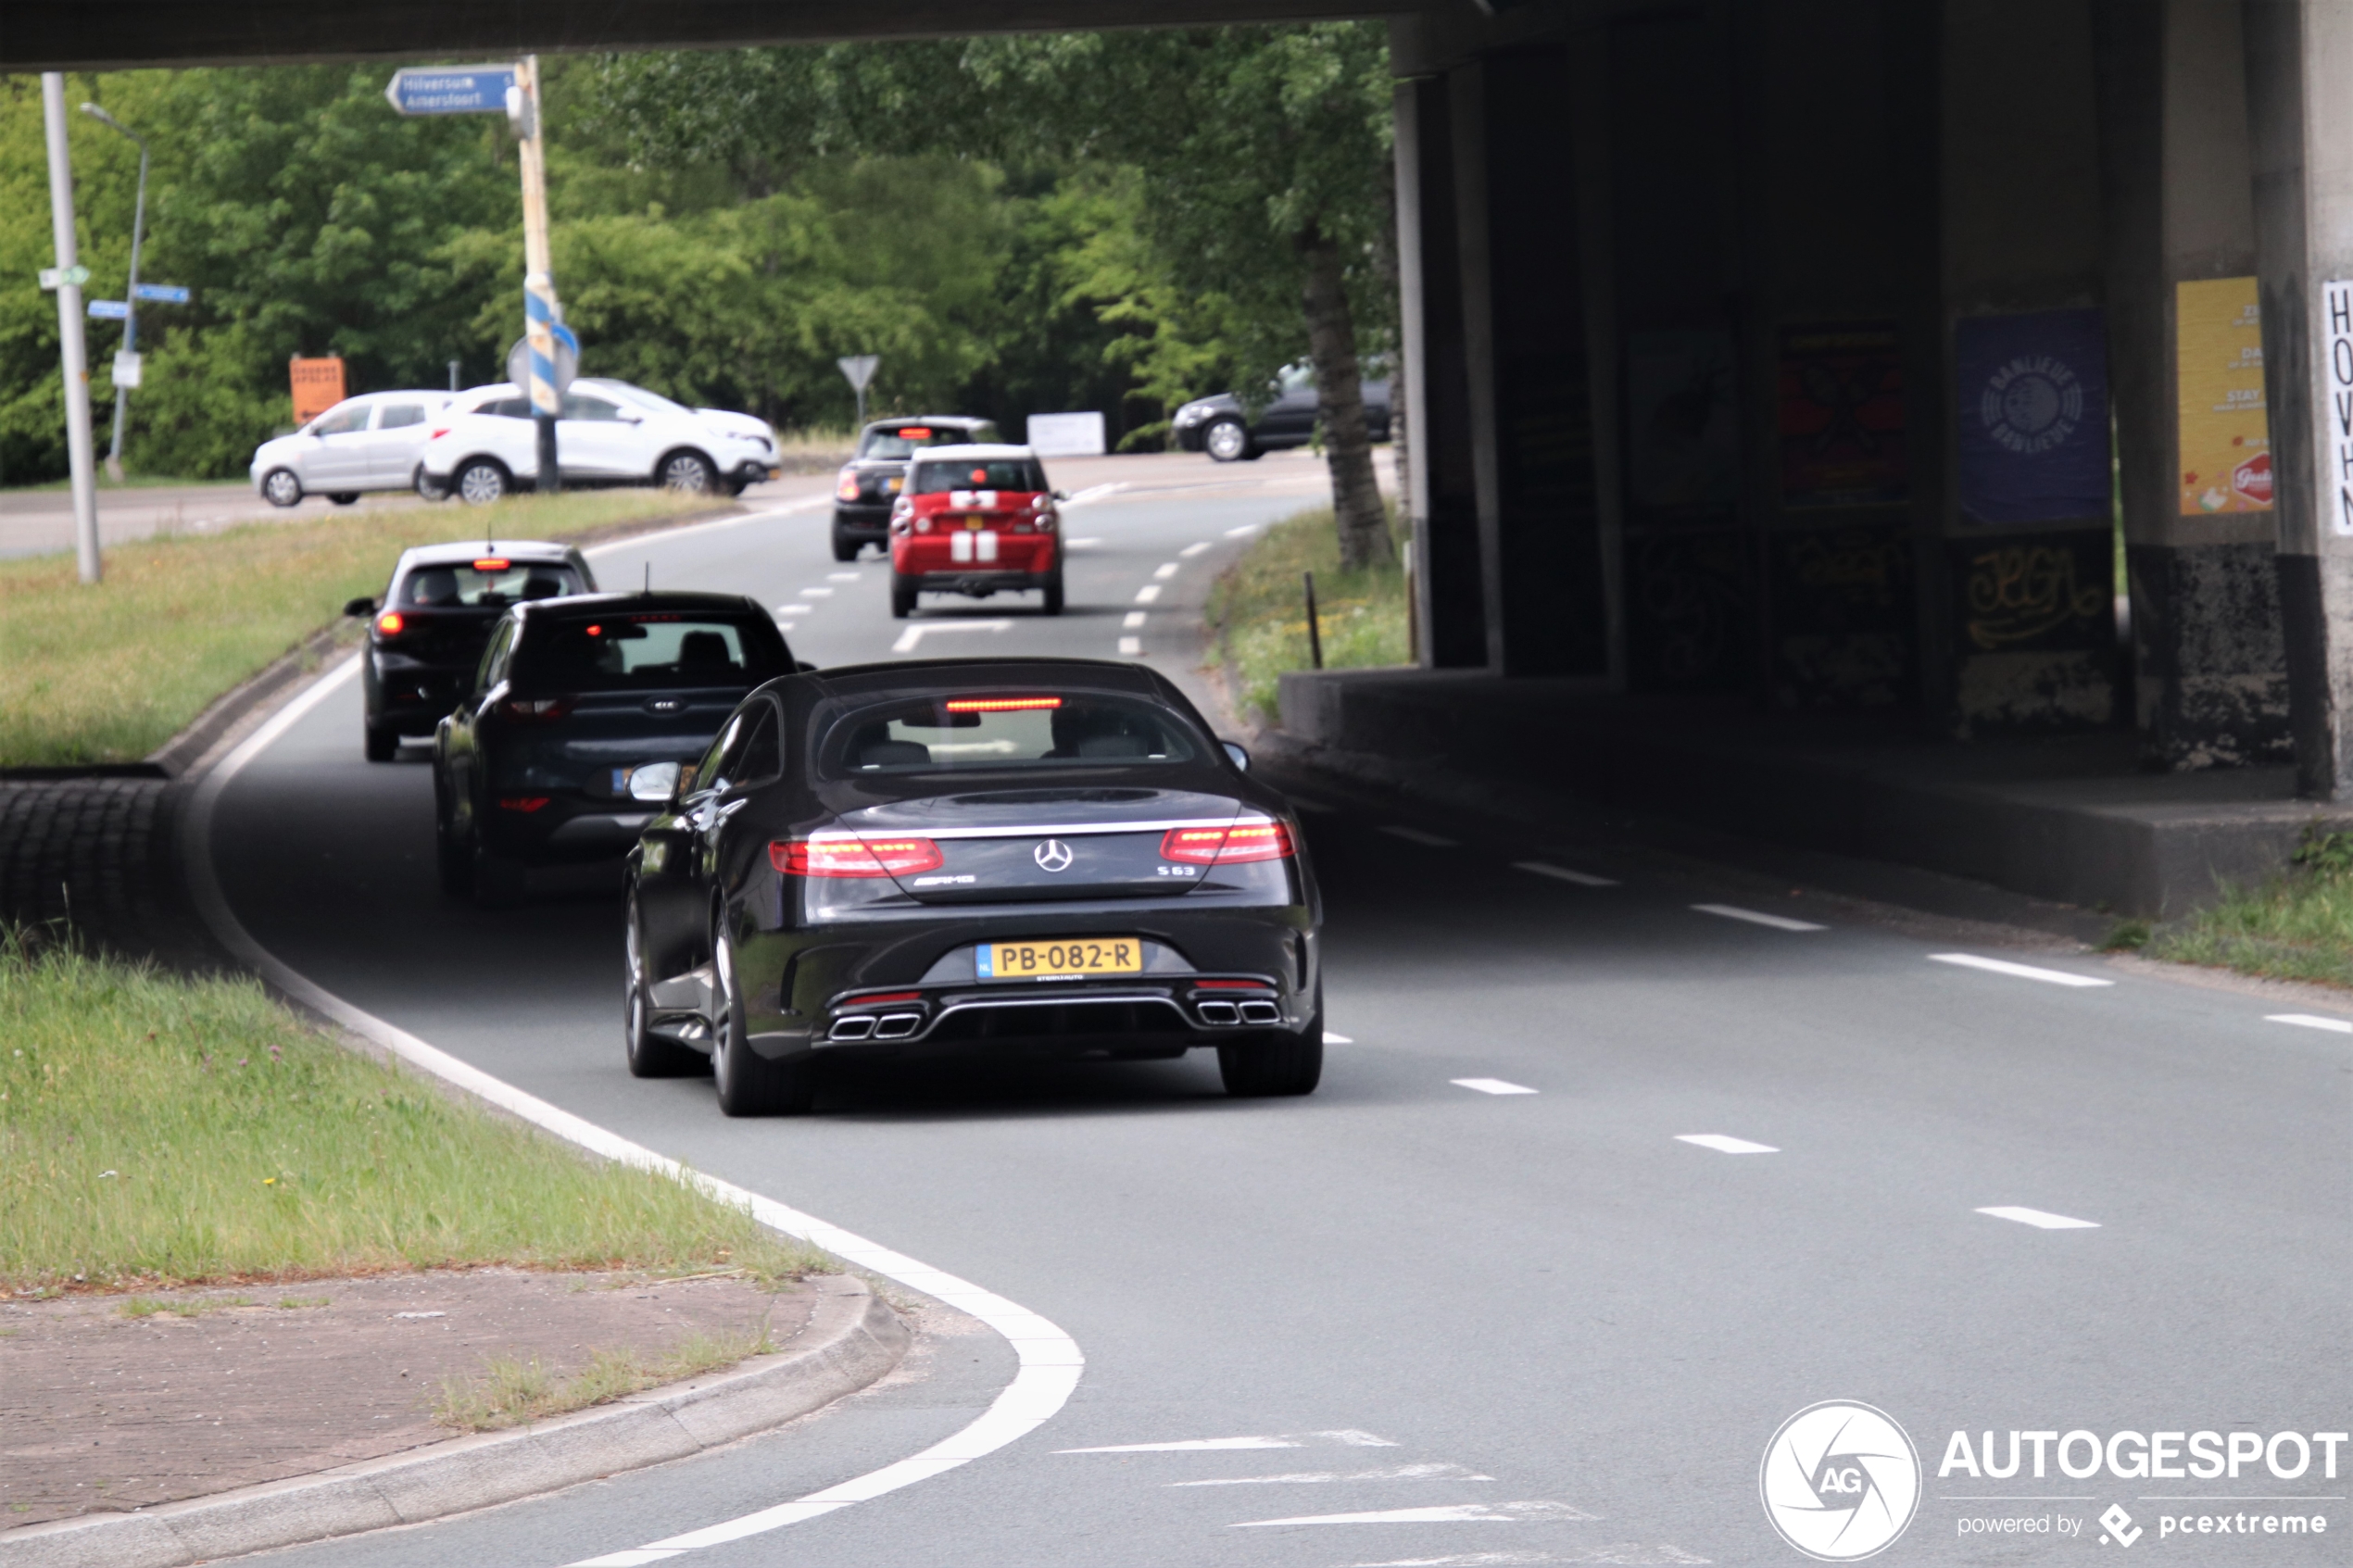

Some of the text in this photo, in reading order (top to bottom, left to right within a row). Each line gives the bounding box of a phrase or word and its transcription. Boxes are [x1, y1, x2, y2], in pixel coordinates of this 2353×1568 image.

[2227, 389, 2260, 402] STAY
[1157, 866, 1195, 876] S 63
[1001, 944, 1131, 972] PB-082-R
[979, 964, 990, 972] NL
